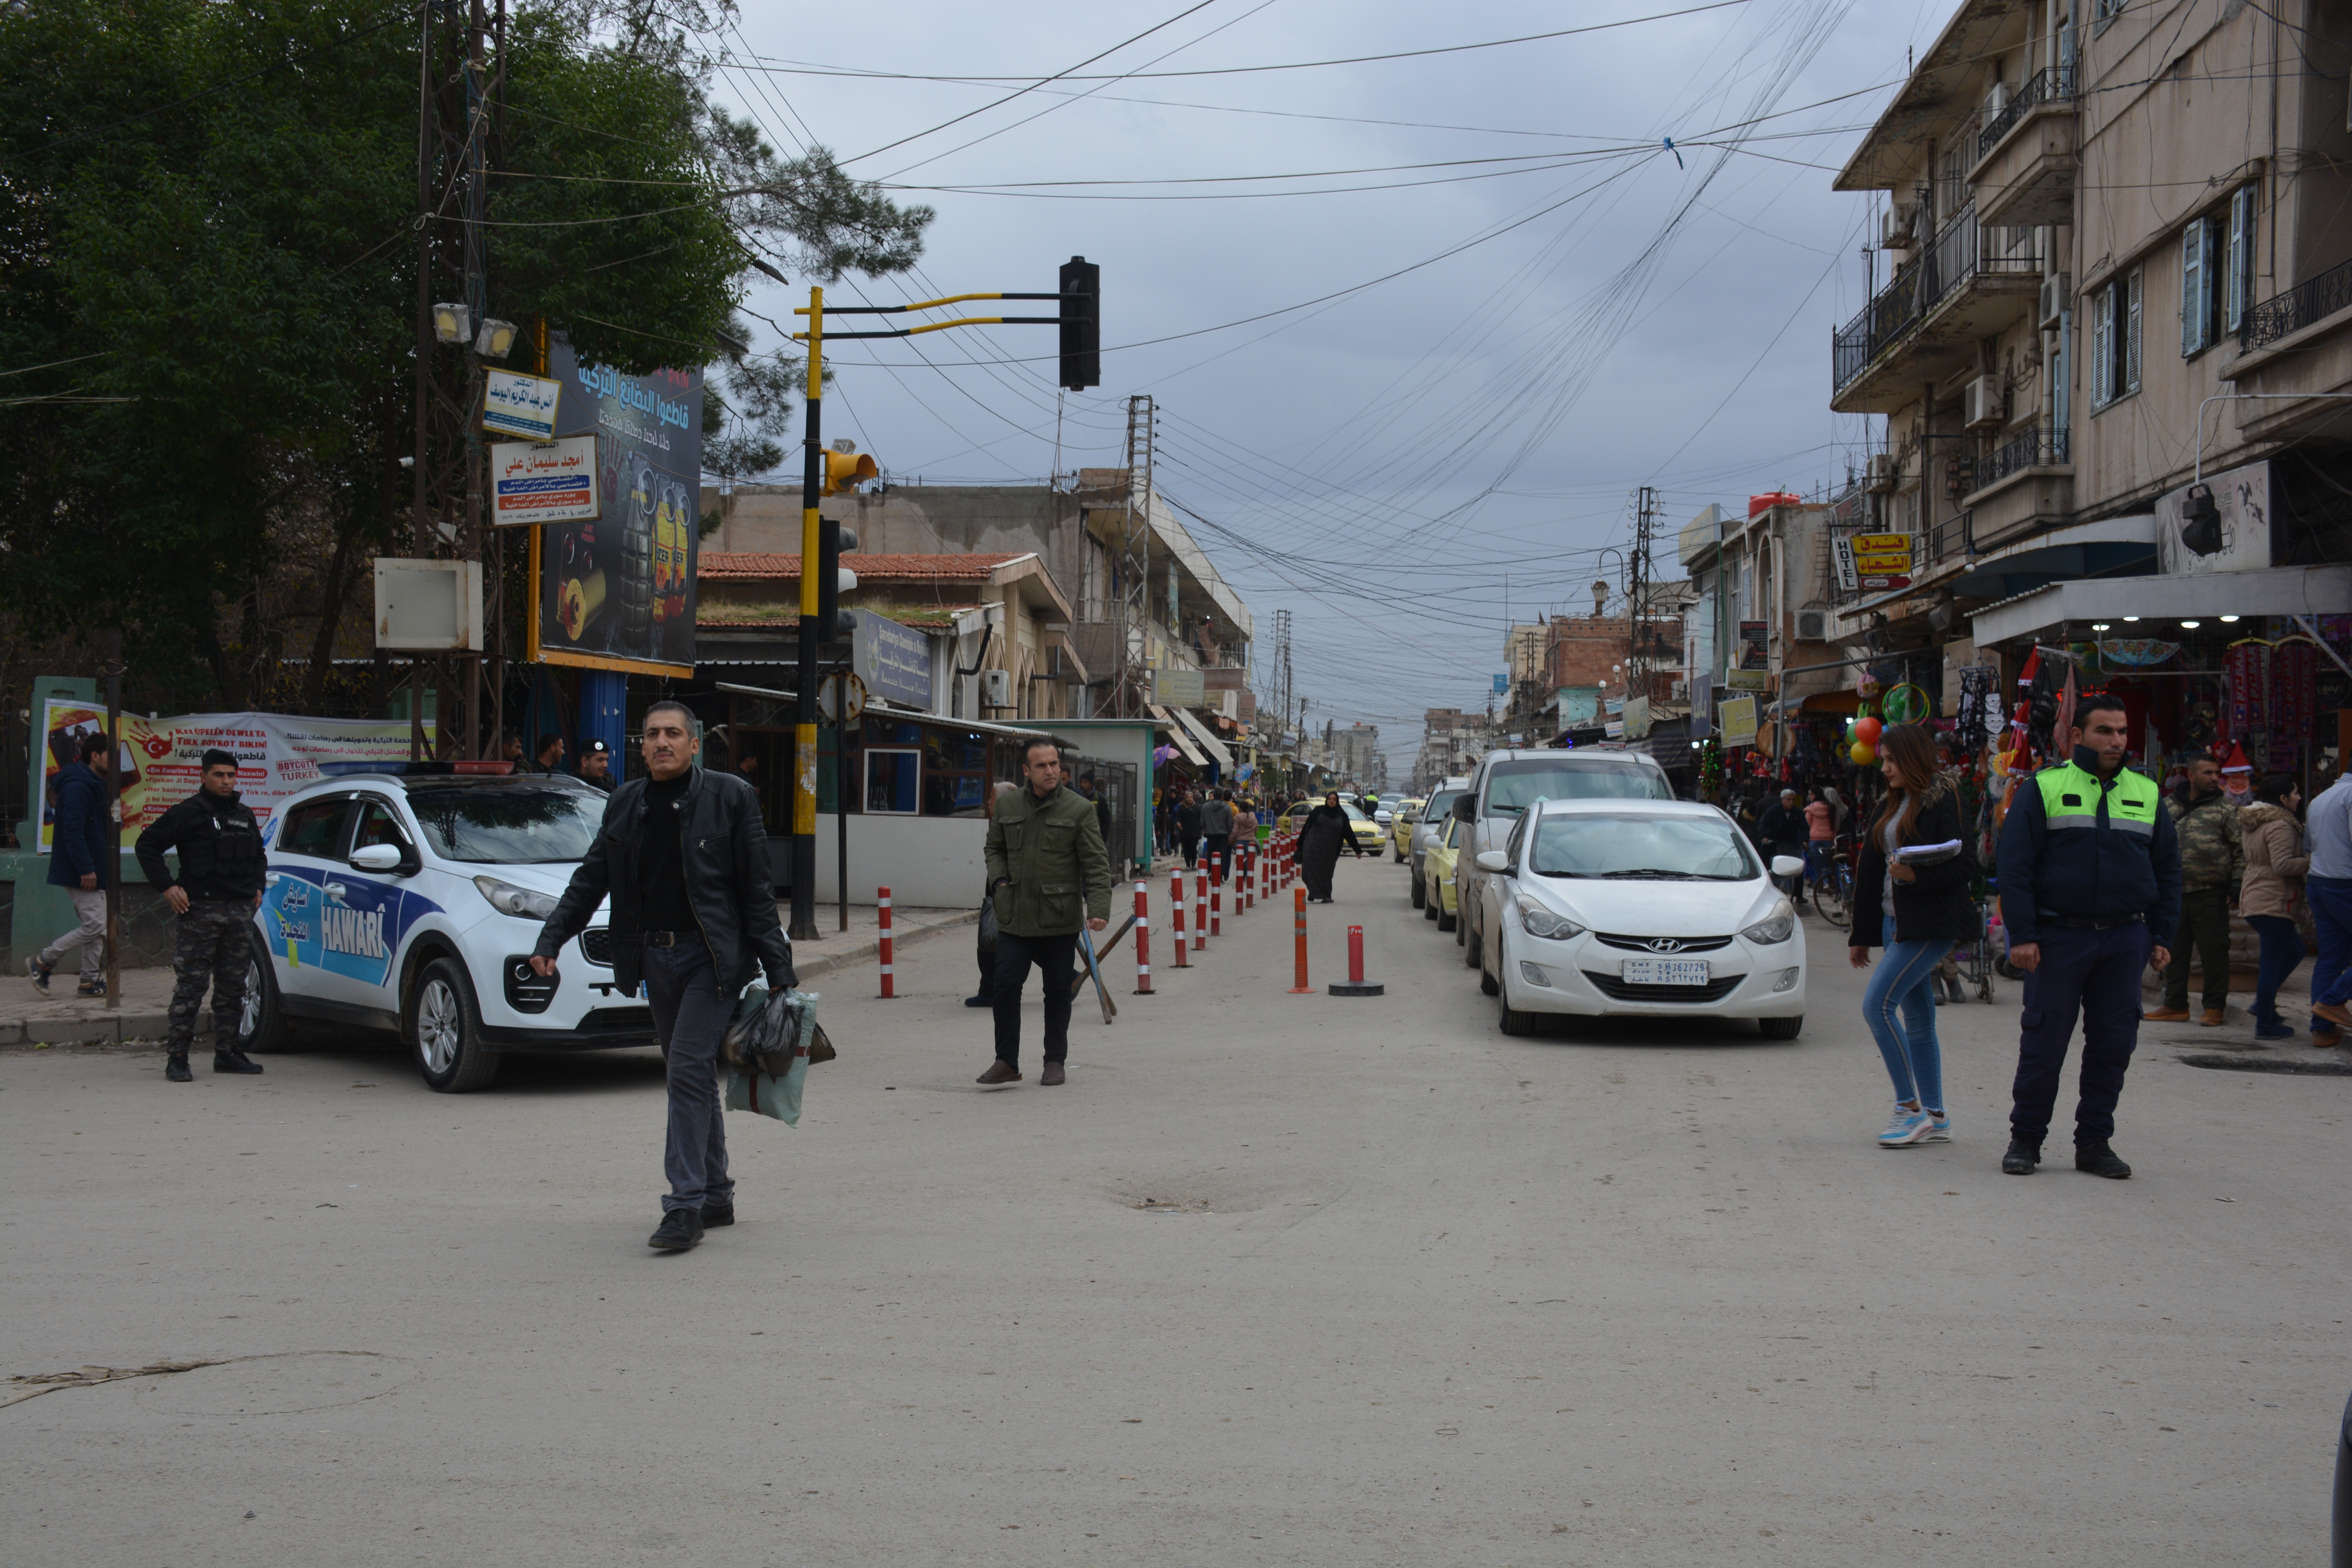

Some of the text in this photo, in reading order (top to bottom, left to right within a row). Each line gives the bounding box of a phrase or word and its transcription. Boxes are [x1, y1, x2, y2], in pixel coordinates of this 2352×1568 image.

[514, 379, 534, 388] الدكتور
[491, 384, 511, 402] اليوسف
[511, 389, 529, 405] الكريم
[619, 377, 654, 418] البضائع
[530, 394, 540, 408] عبد
[657, 394, 688, 429] قاطعوا
[530, 441, 559, 450] الدكتور
[506, 449, 583, 477] أمجد سليمان علي
[1861, 536, 1904, 551] فندق
[1838, 542, 1855, 587] HOTEL
[1861, 557, 1908, 572] الشهباء
[226, 729, 266, 738] DEWLETA
[308, 735, 331, 743] رصاصات
[201, 739, 236, 748] BOYKOT
[239, 740, 267, 749] BIKIN!
[235, 751, 266, 762] قاطعوا
[278, 760, 316, 771] BOYCOTT
[281, 771, 319, 781] TURKEY
[279, 918, 310, 945] النجدة
[321, 903, 386, 959] HAWARÎ
